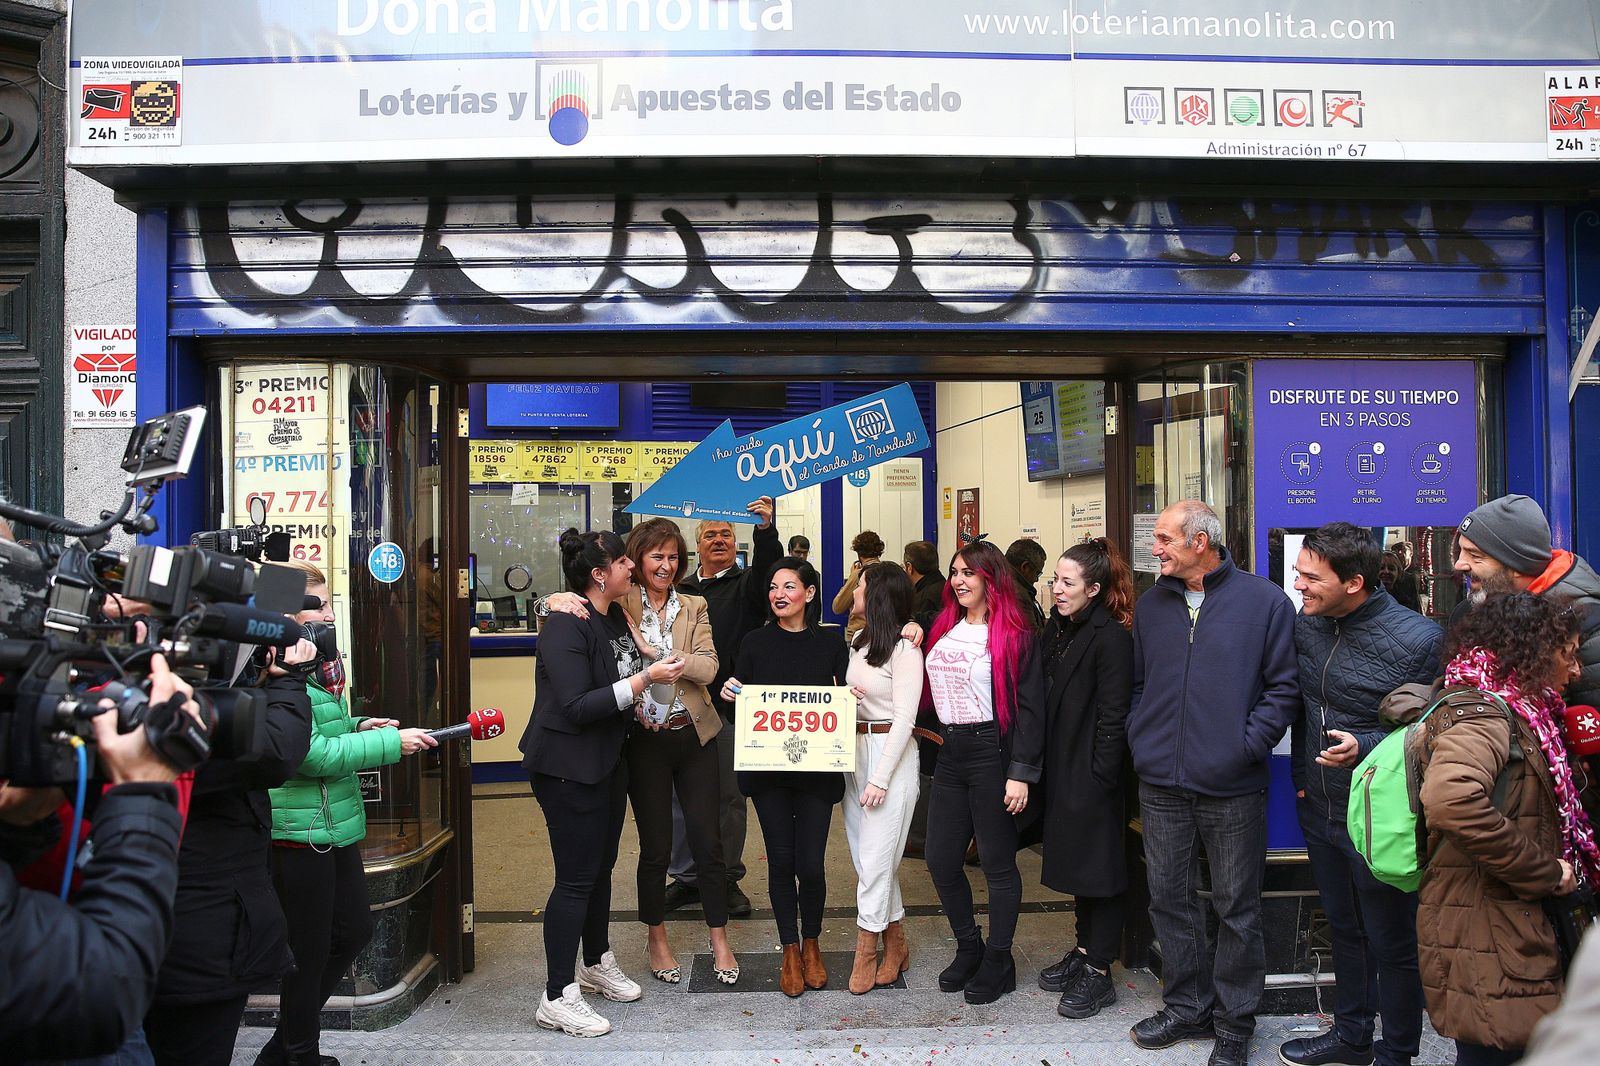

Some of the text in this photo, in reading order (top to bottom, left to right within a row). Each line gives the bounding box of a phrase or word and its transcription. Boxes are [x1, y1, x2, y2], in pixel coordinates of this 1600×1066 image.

[963, 9, 1396, 40] www.loteriamanolita.com
[83, 60, 181, 69] ZONA VIDEOVIGILADA
[359, 81, 962, 121] Loterías y Apuestas del Estado
[88, 127, 117, 140] 24h
[1206, 142, 1367, 157] Administración nº 67
[1556, 138, 1583, 151] 24h
[235, 380, 253, 394] 3er
[507, 384, 600, 394] FELIZ NAVIDAD
[252, 395, 315, 414] 04211
[1269, 390, 1459, 405] DISFRUTE DE SU TIEMPO
[1034, 409, 1044, 426] 25
[1319, 412, 1411, 427] EN 3 PASOS
[537, 446, 574, 454] PREMIO
[597, 447, 633, 455] PREMIO
[736, 417, 836, 491] aquí
[235, 456, 257, 473] 4º
[473, 455, 506, 463] 18596
[532, 455, 567, 464] 47862
[592, 456, 627, 464] 07568
[799, 471, 809, 481] el
[812, 456, 850, 476] Gordo
[851, 449, 866, 464] de
[695, 507, 721, 515] Apuestas
[374, 552, 399, 569] +18
[246, 619, 286, 639] RØDE
[760, 691, 832, 704] 1er PREMIO
[752, 710, 838, 732] 26590
